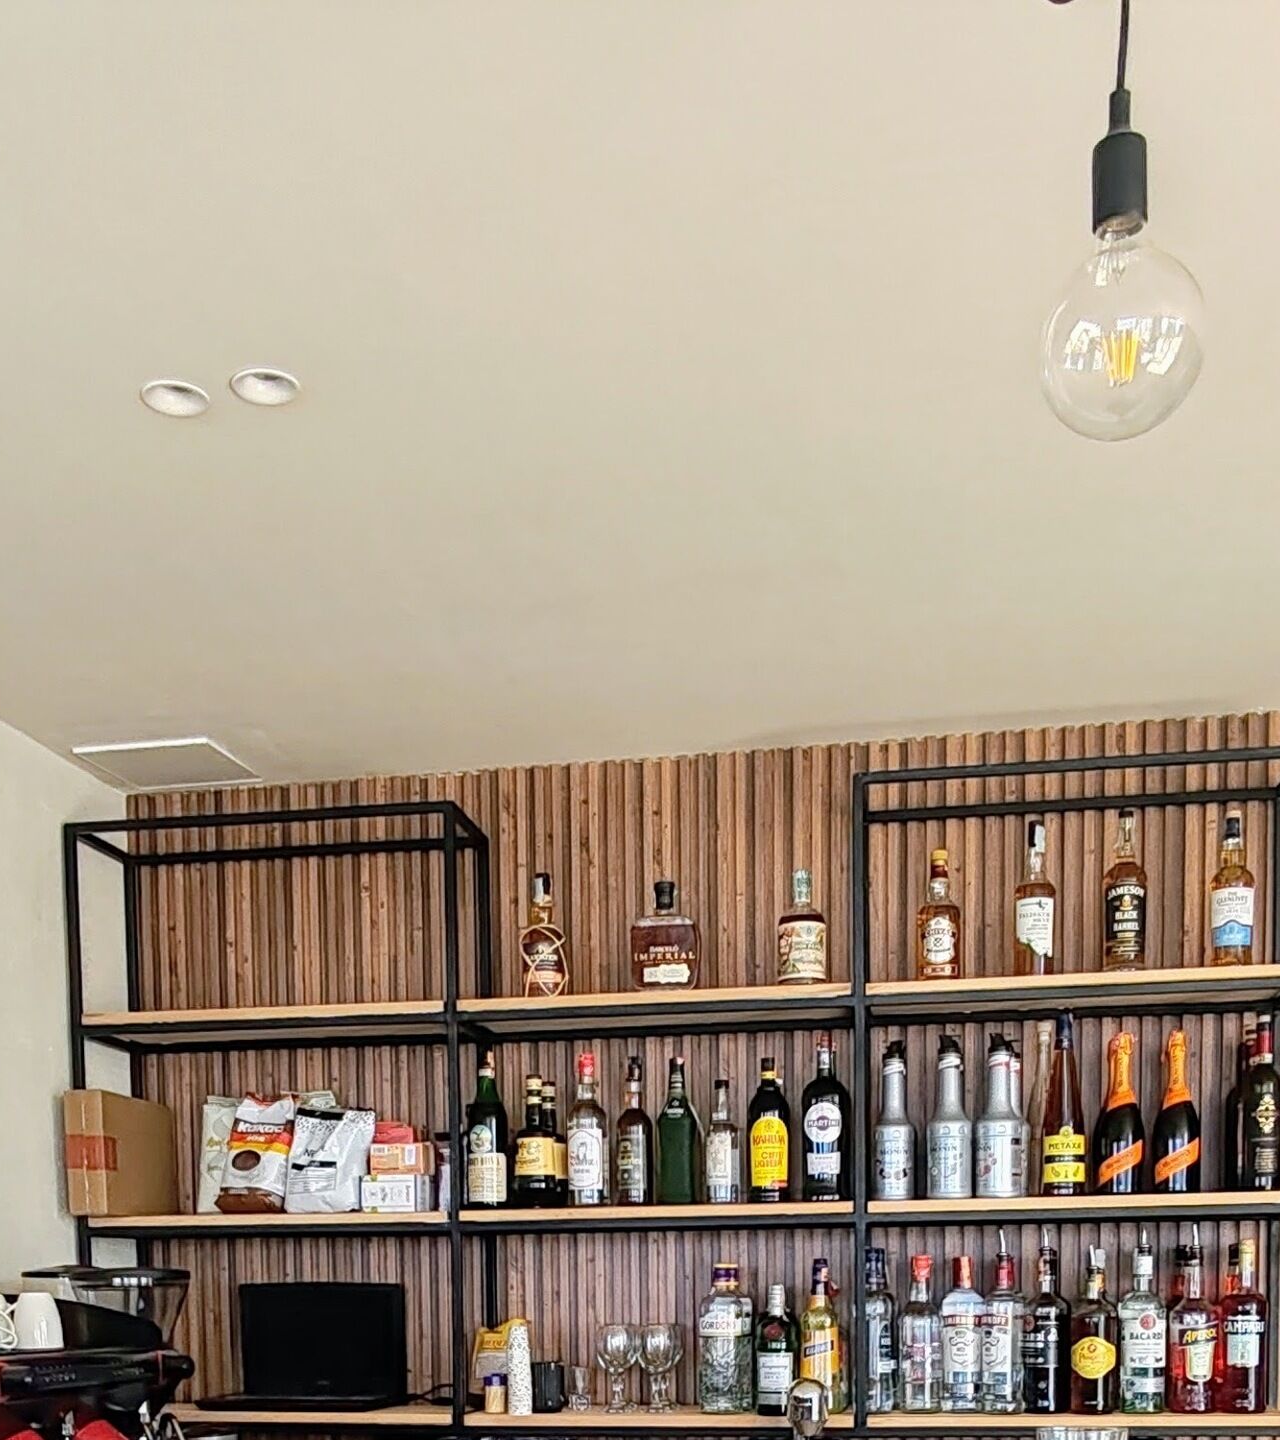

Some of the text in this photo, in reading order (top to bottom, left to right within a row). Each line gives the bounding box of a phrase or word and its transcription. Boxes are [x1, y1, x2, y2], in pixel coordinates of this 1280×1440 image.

[1107, 885, 1145, 900] JAMESON
[634, 951, 696, 961] IMPERIAL
[1223, 1321, 1265, 1333] CAMPARI
